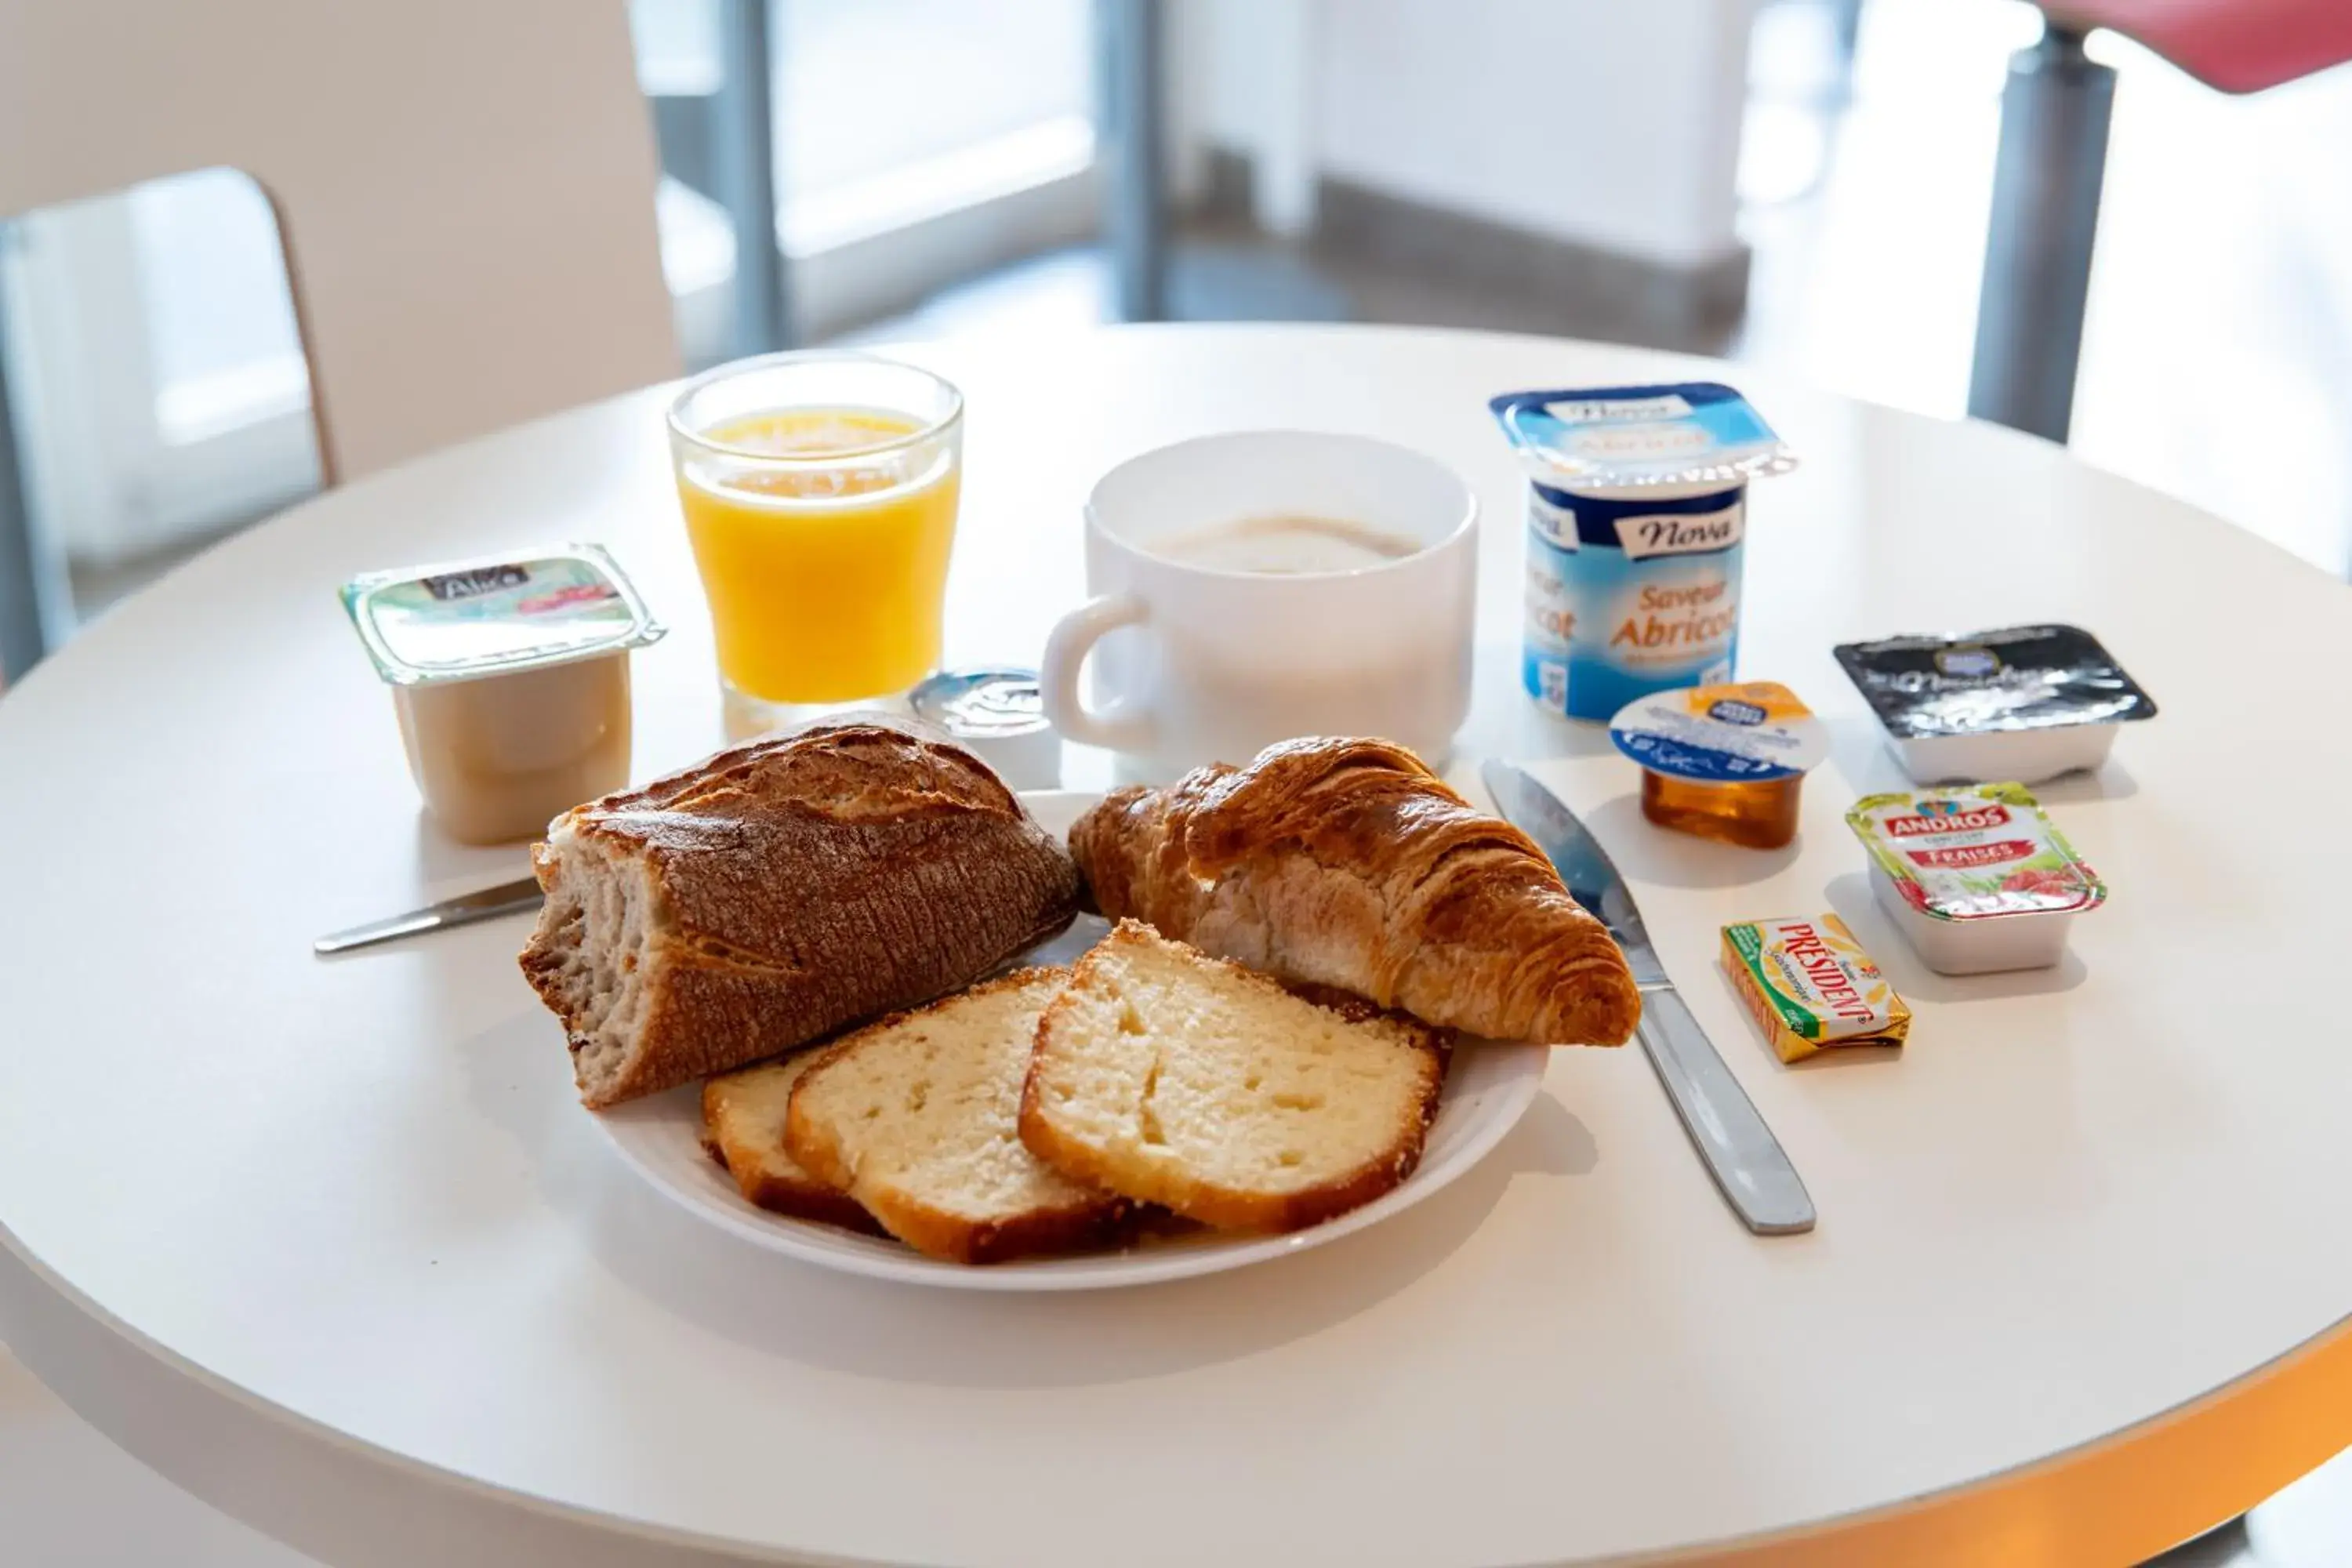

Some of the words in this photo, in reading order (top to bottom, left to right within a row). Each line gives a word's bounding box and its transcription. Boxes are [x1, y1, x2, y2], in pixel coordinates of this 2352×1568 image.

[1639, 521, 1730, 546] Nova
[1638, 581, 1727, 611] Saveur
[1610, 603, 1735, 648] Abricot
[1893, 805, 2003, 835] ANDROS
[1926, 843, 2013, 865] FRAISES
[1778, 923, 1875, 1021] PRÉSIDENT
